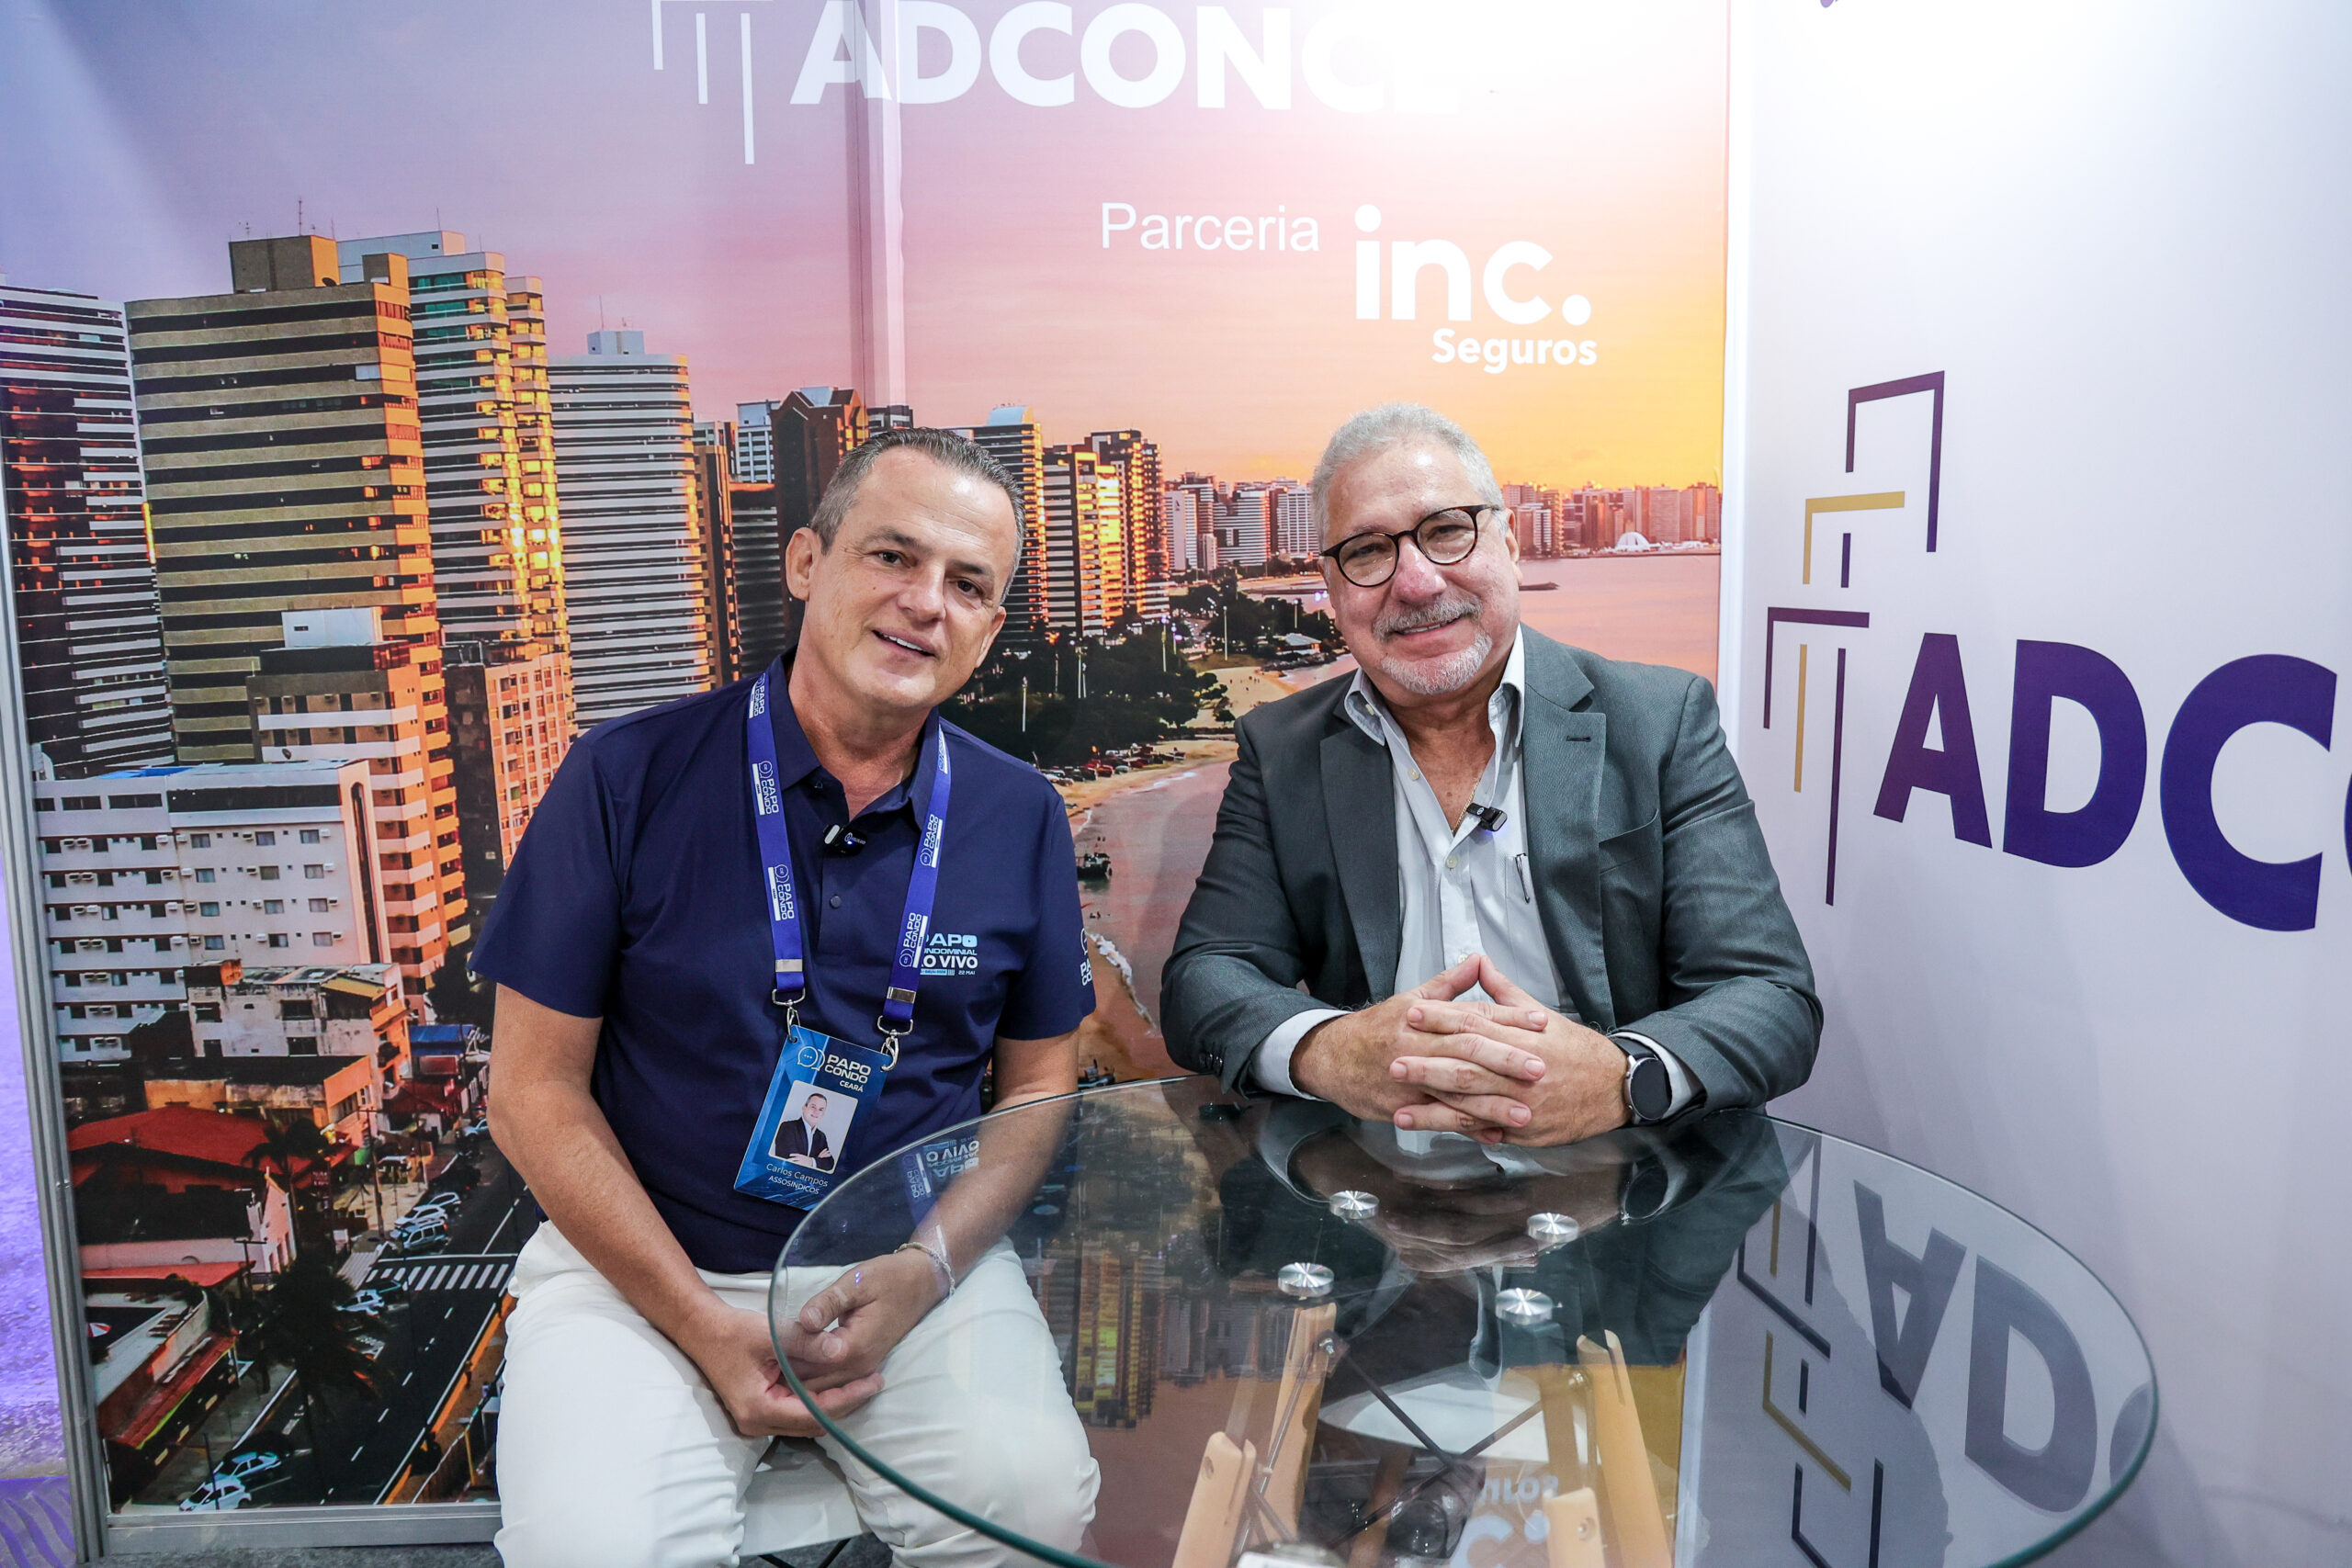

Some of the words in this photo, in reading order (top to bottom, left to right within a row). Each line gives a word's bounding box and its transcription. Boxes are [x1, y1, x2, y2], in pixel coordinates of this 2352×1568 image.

[1102, 201, 1319, 253] Parceria
[1353, 203, 1592, 326] inc.
[1430, 327, 1599, 375] Seguros
[761, 780, 773, 815] CONDO
[766, 778, 779, 814] PAPO
[1873, 632, 2352, 931] ADC
[923, 814, 935, 848] PAPO
[929, 816, 939, 850] CONDO
[777, 885, 788, 920] CONDO
[784, 883, 795, 919] PAPO
[903, 912, 917, 948] PAPO
[910, 913, 922, 949] CONDO
[925, 932, 978, 948] APO
[923, 947, 978, 955] NDOMINIAL
[939, 955, 978, 969] VIVO
[824, 1064, 868, 1084] CONDO
[827, 1054, 872, 1076] PAPO
[839, 1080, 864, 1092] CEARÁ
[766, 1163, 792, 1177] Carlos
[794, 1171, 829, 1187] Campos
